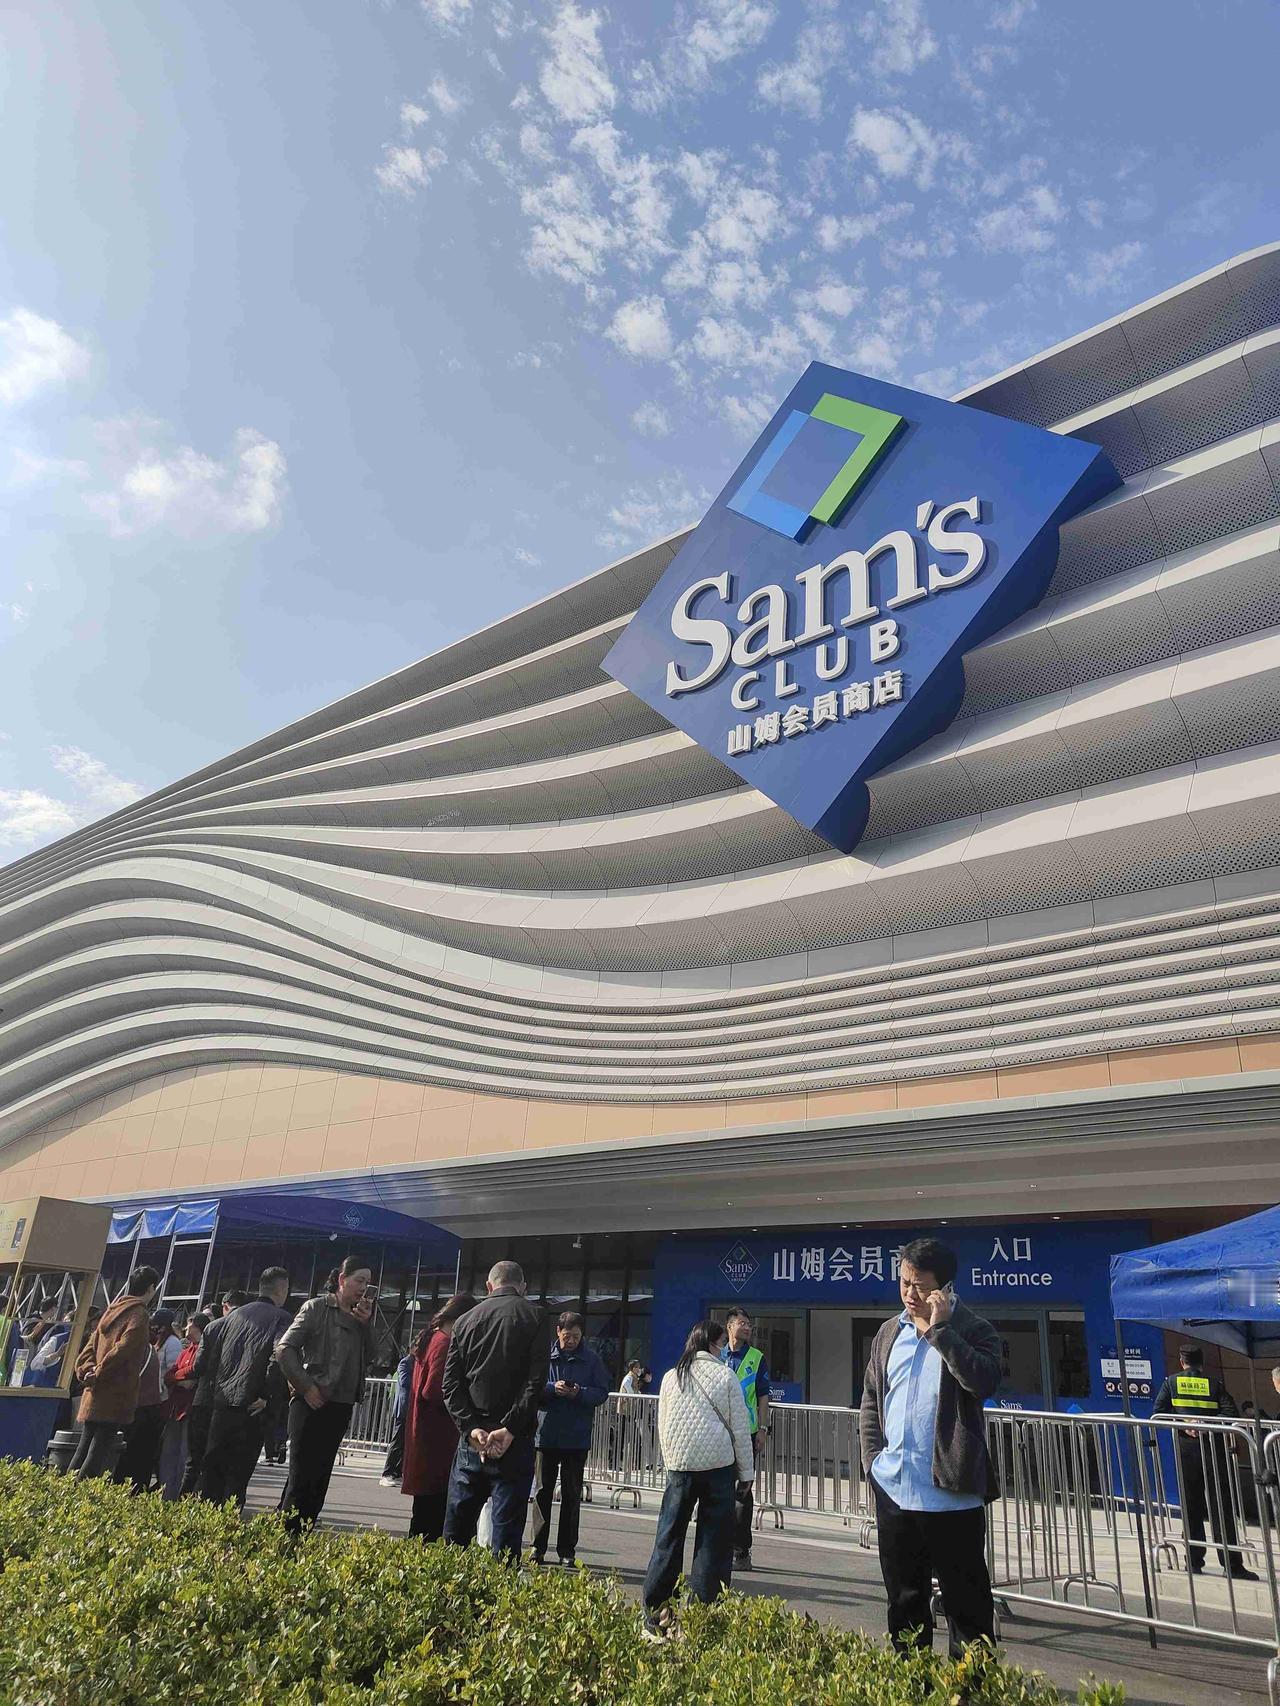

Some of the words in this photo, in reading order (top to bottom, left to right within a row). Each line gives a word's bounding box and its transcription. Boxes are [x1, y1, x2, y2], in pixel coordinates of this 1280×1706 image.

[666, 496, 987, 697] Sam's
[730, 618, 900, 711] CLUB
[727, 669, 903, 756] 山姆会员商店
[972, 1267, 1053, 1286] Entrance
[989, 1237, 1032, 1262] 入口
